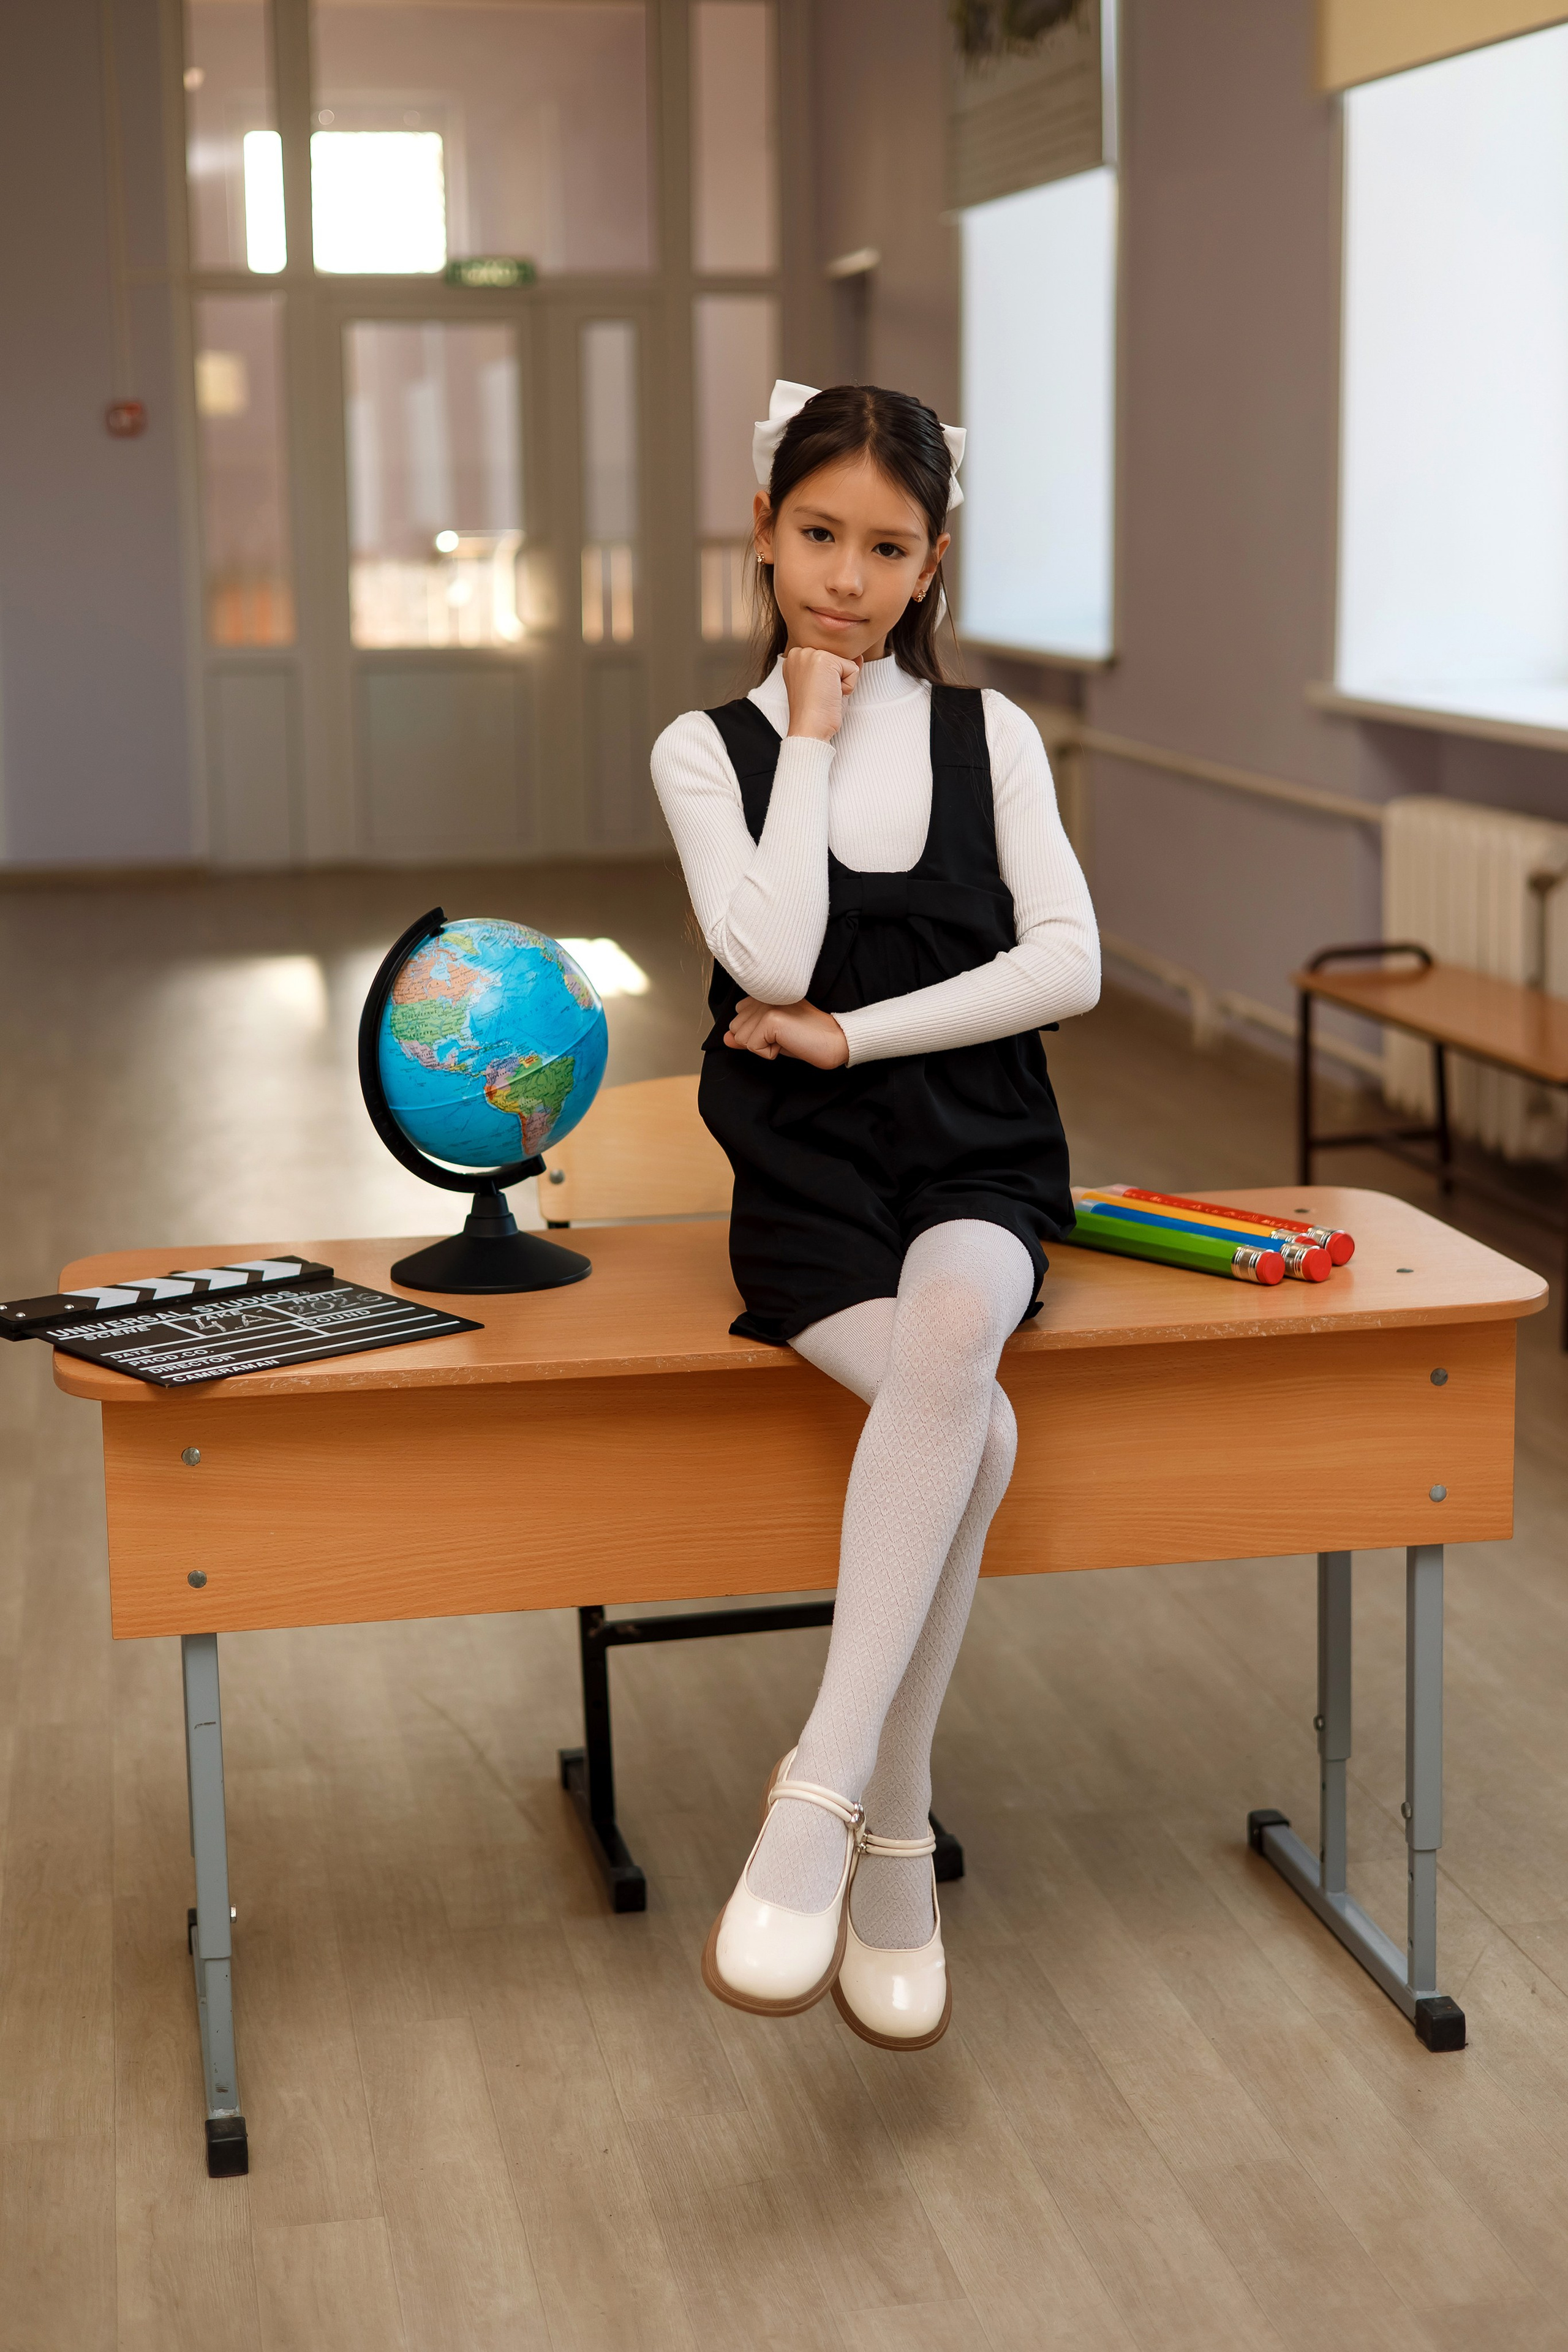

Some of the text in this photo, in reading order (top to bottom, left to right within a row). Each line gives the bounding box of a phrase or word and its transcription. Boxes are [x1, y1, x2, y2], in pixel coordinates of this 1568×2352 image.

[288, 1292, 383, 1316] 2026
[292, 1292, 344, 1305] ROLL
[46, 1310, 191, 1337] UNIVERSAL
[190, 1310, 244, 1322] TAKE
[303, 1310, 371, 1325] SOUND
[83, 1325, 151, 1341] SCENE
[110, 1349, 153, 1360] DATE
[148, 1355, 236, 1374] DIRECTOR
[172, 1359, 280, 1382] CAMERAMAN
